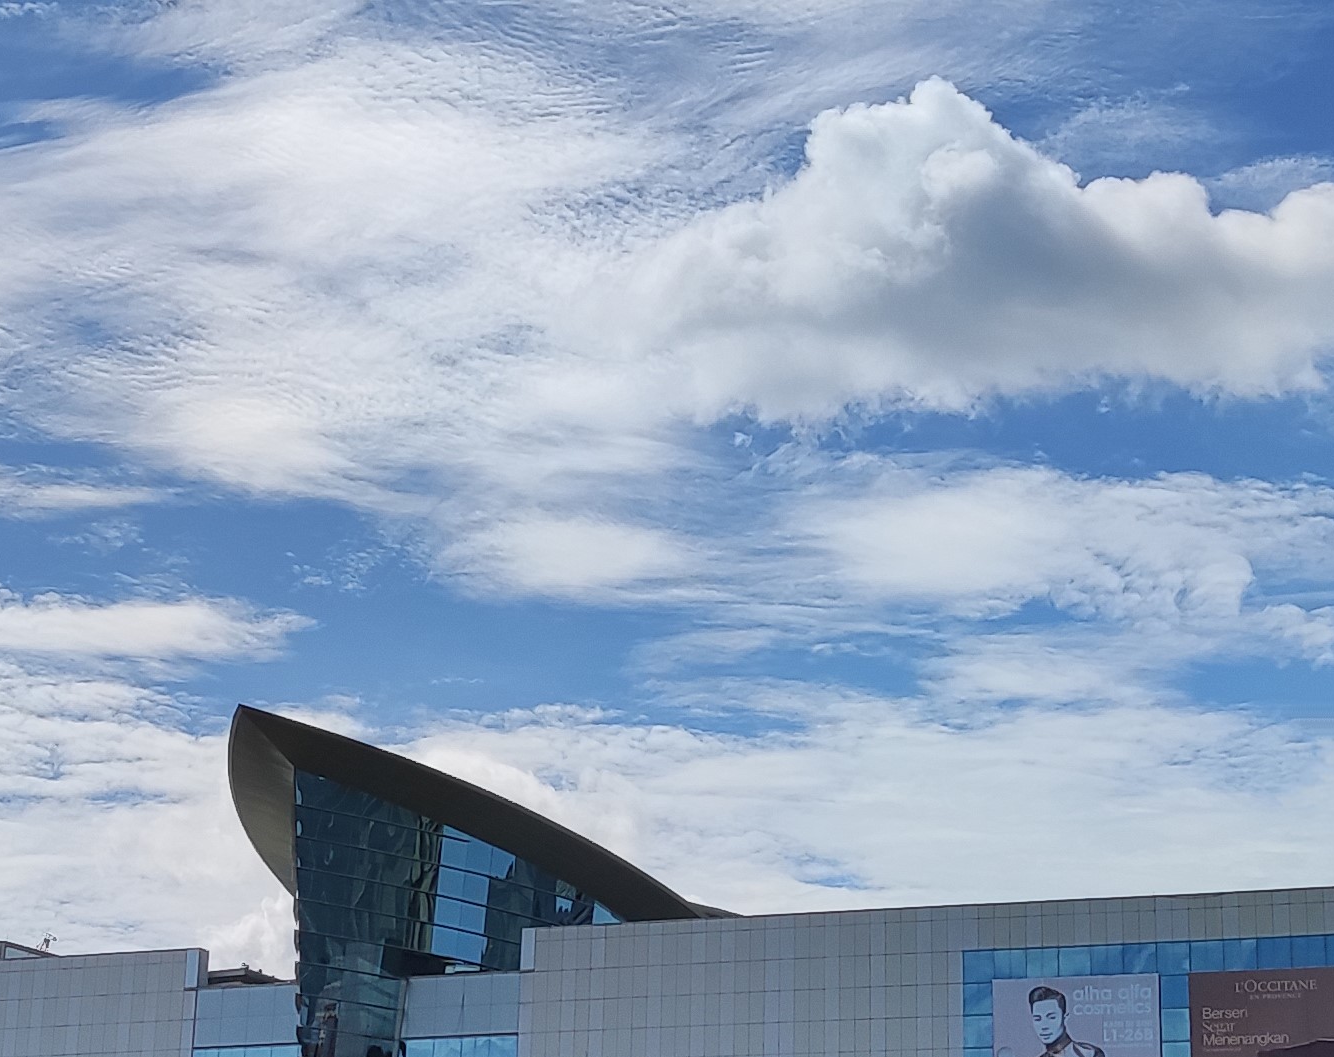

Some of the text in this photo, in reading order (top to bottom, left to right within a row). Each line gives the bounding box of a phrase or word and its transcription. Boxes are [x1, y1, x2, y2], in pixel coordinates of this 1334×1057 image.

[1073, 983, 1152, 1001] alha alfa
[1235, 979, 1318, 993] L'OCCITANE
[1073, 1001, 1152, 1016] cosmetics
[1203, 1032, 1290, 1047] Menenangkan
